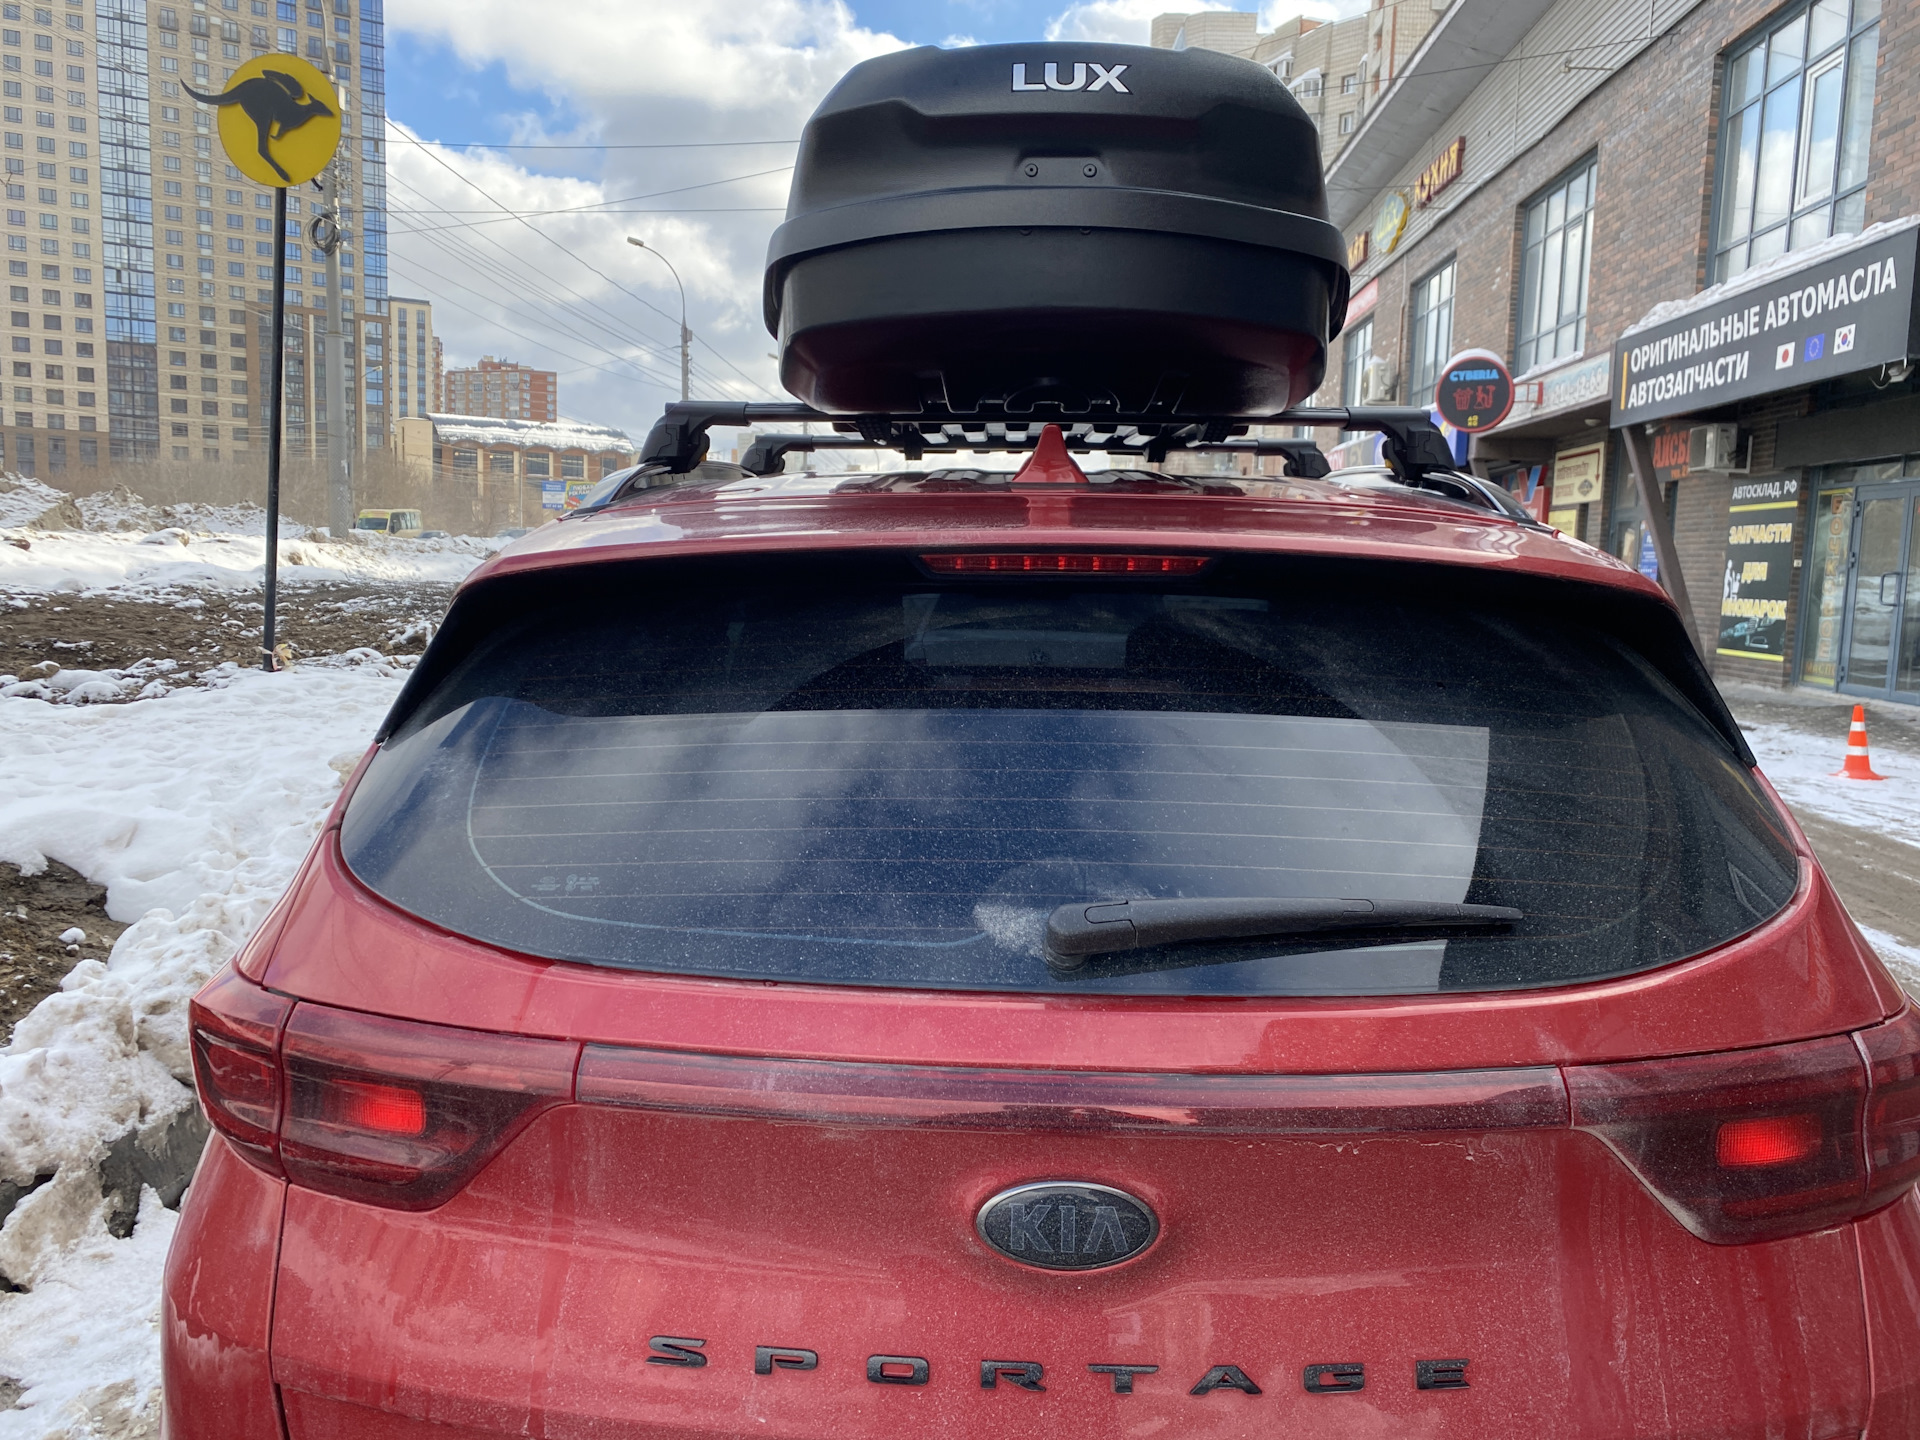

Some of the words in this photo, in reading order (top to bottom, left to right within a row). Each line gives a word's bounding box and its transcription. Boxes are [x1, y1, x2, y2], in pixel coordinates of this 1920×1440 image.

[1012, 62, 1131, 94] LUX
[1414, 141, 1460, 203] КУХНЯ
[1630, 305, 1760, 374] ОРИГИНАЛЬНЫЕ
[1763, 256, 1897, 332] АВТОМАСЛА
[1449, 368, 1500, 382] CYBERIA
[1627, 350, 1750, 410] АВТОЗАПЧАСТИ
[1783, 479, 1798, 495] РФ
[1729, 523, 1793, 544] ЗАПЧАСТИ
[1740, 562, 1769, 584] ДЛЯ
[1721, 597, 1788, 620] ИНОМАРОК
[1009, 1203, 1129, 1254] KIA
[645, 1335, 1472, 1396] SPORTAGE
